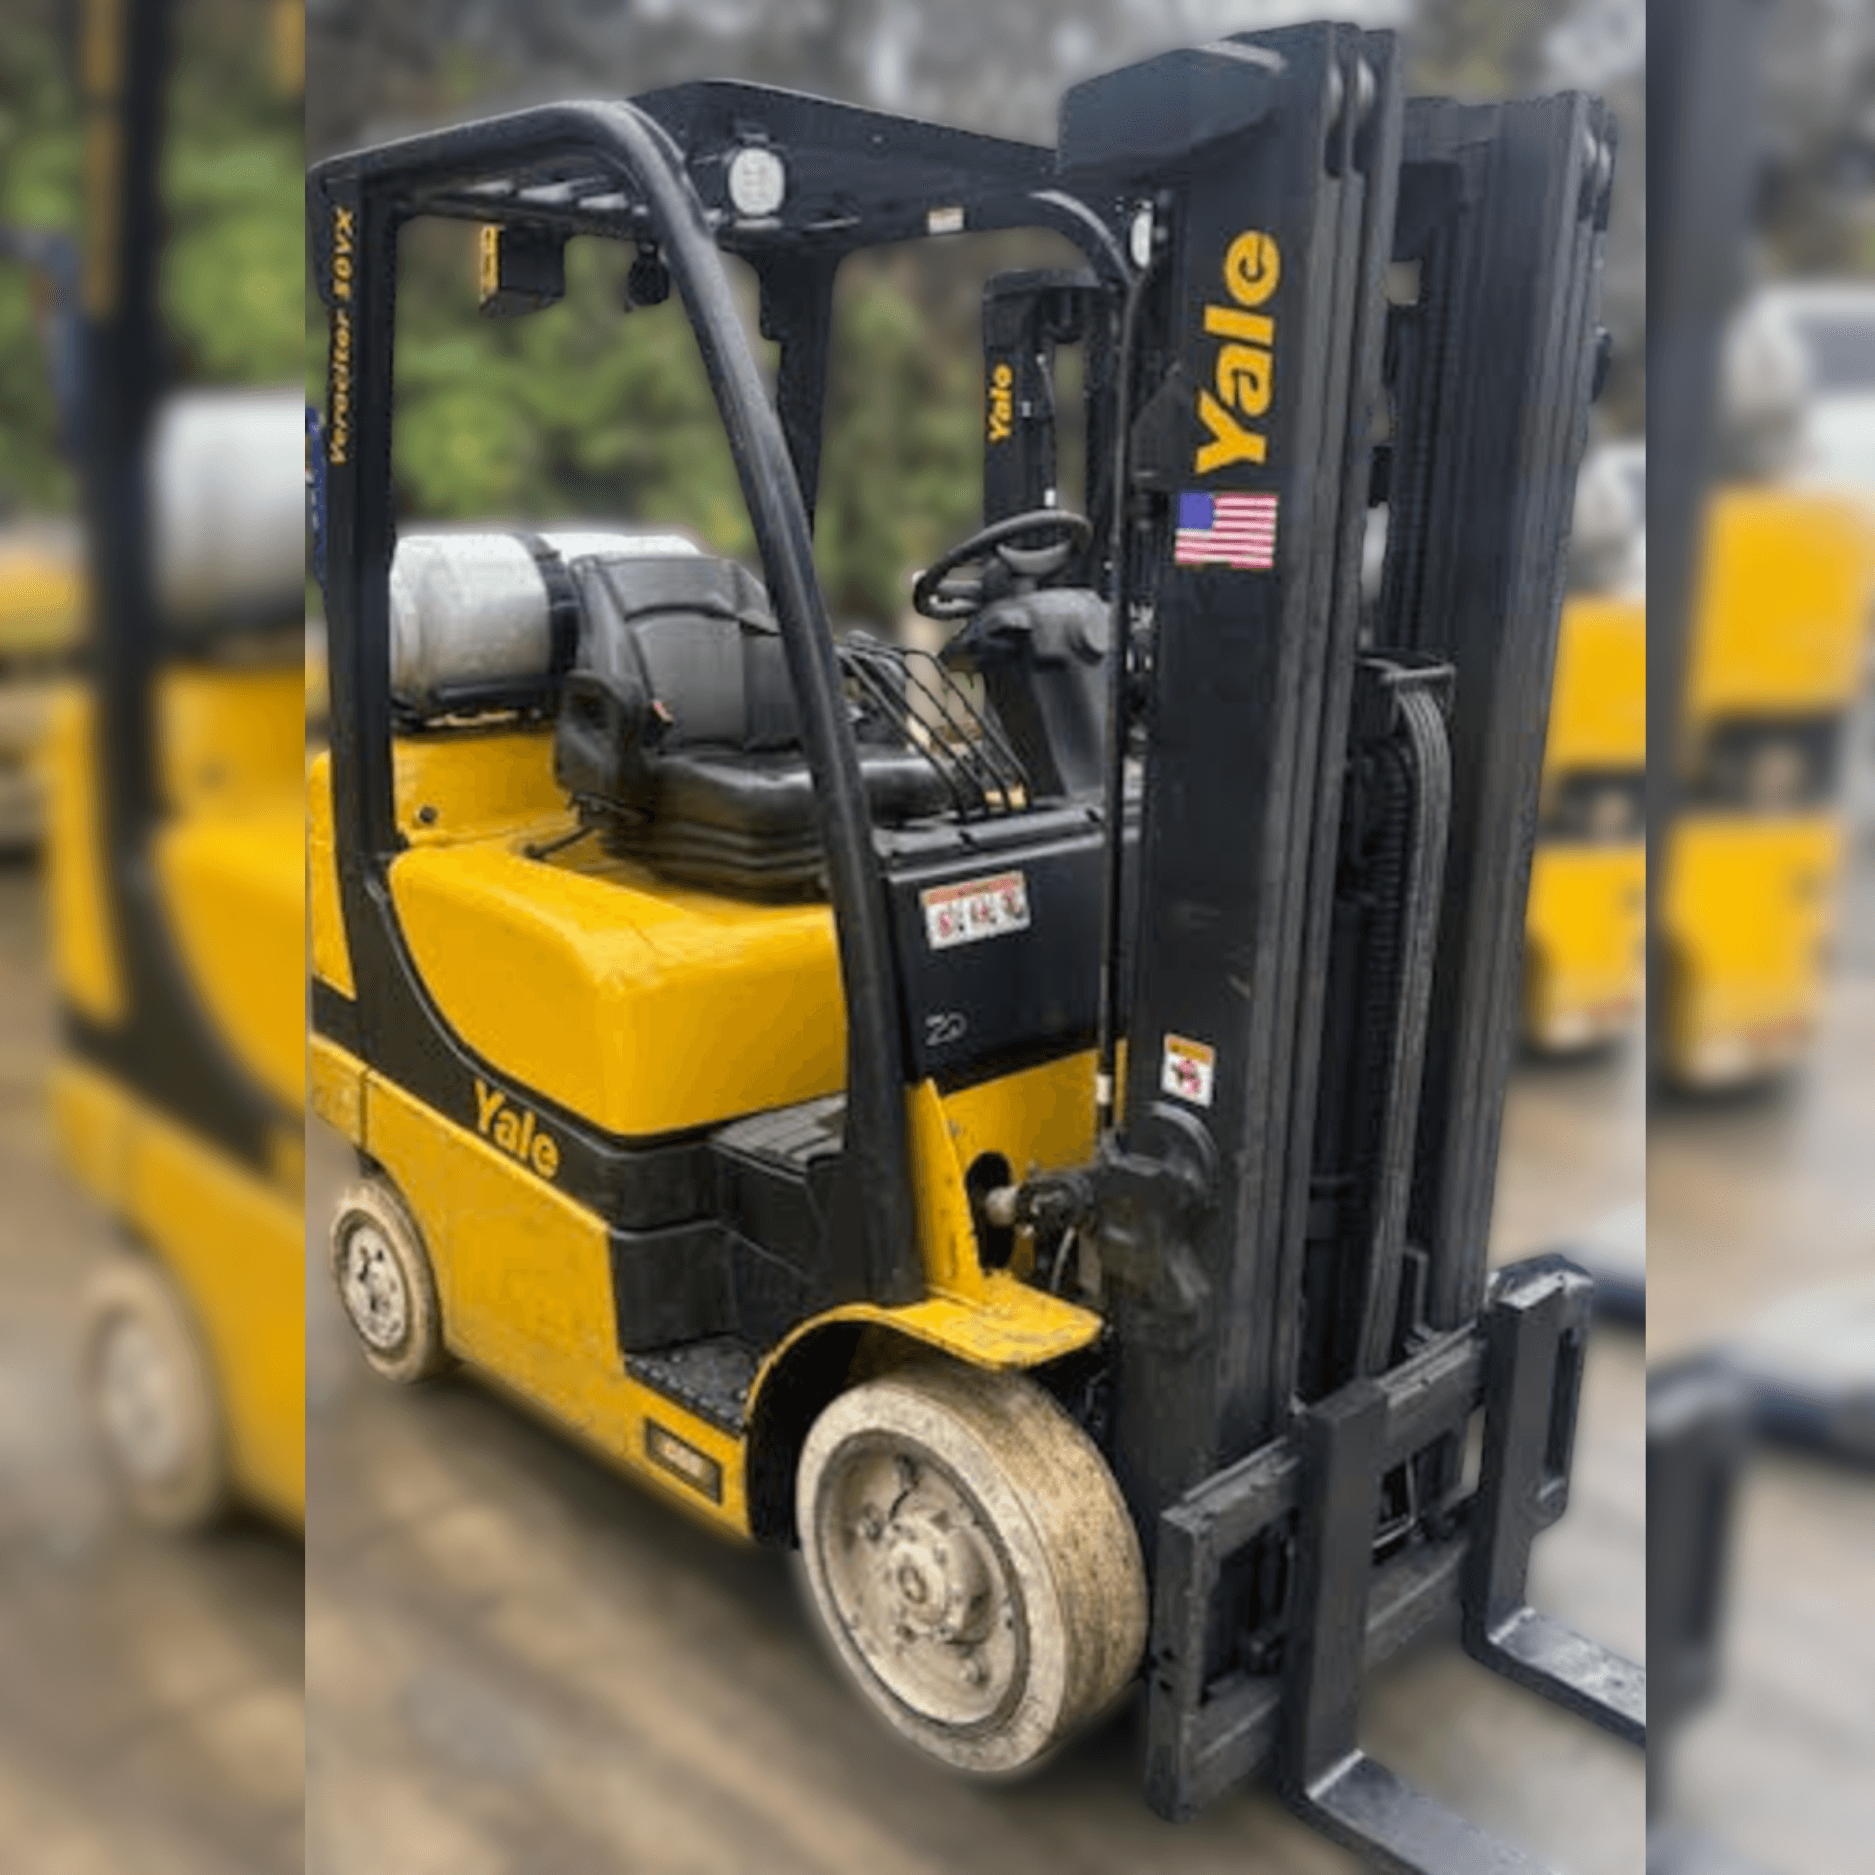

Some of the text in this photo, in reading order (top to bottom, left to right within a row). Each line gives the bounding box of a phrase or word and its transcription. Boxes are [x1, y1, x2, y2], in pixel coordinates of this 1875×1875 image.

[1194, 229, 1281, 474] Yale
[988, 363, 1013, 442] Yale
[474, 1078, 559, 1178] Yale
